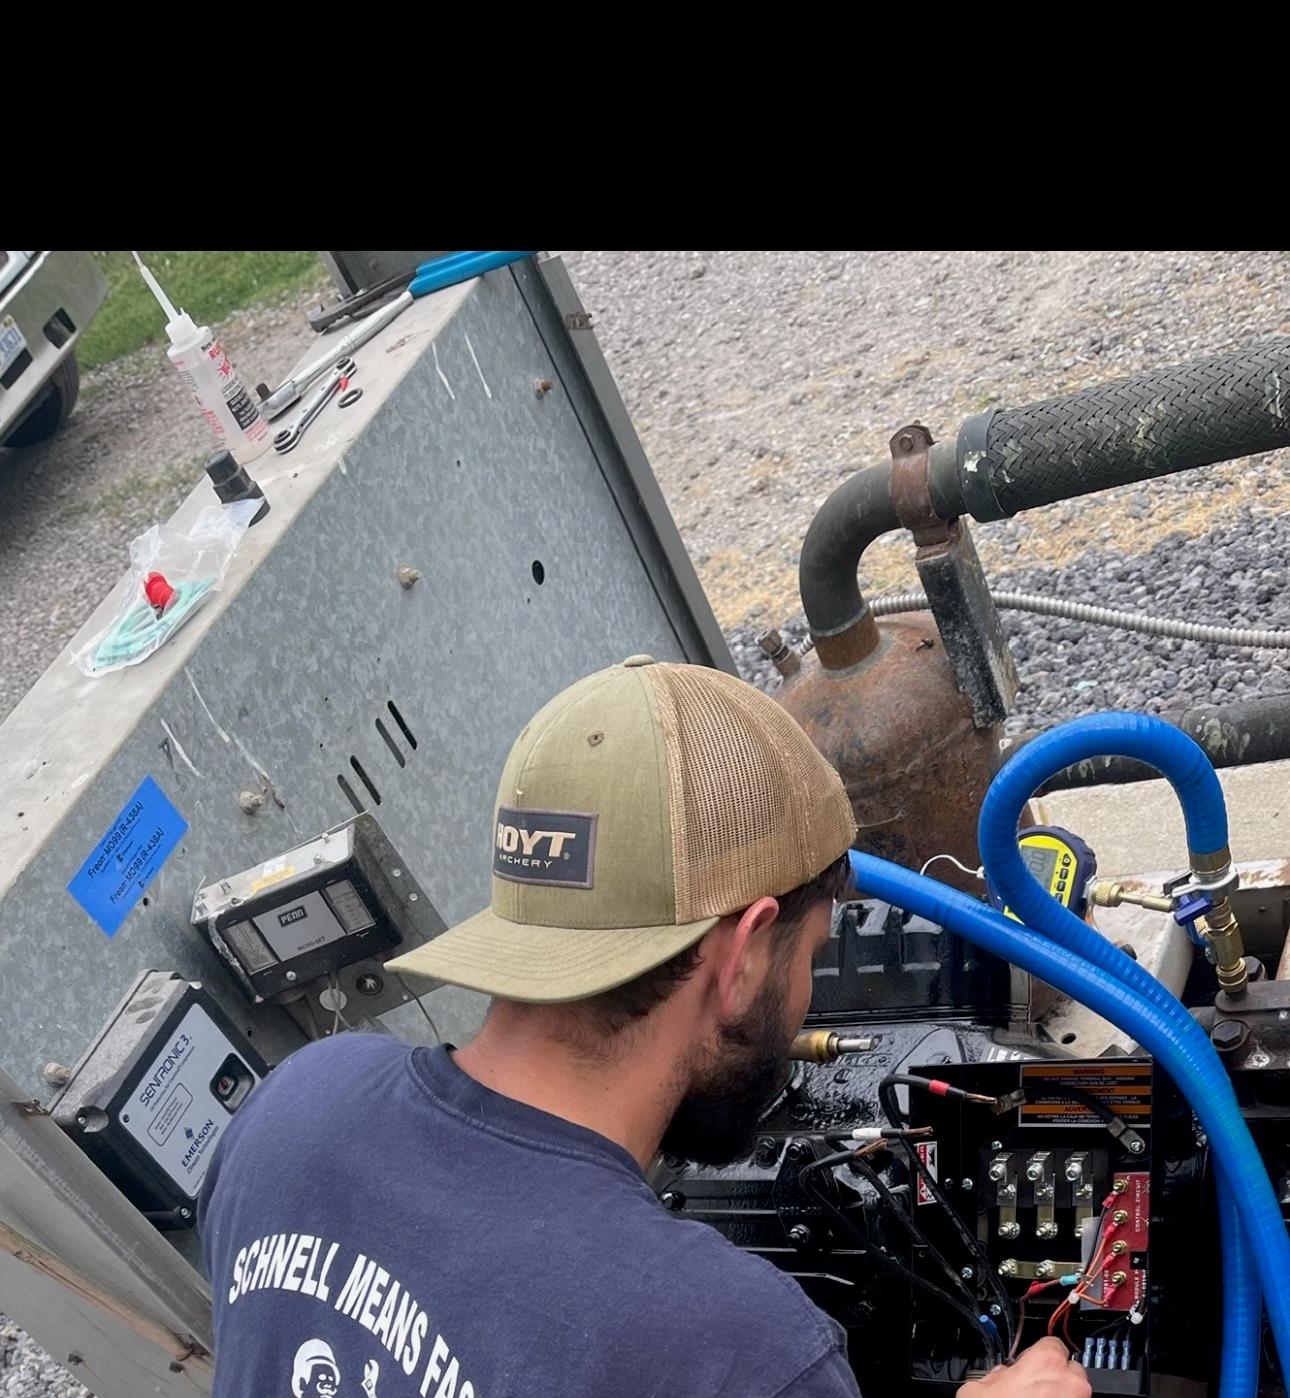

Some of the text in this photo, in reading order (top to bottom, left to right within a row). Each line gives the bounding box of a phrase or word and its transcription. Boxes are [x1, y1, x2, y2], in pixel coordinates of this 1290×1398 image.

[280, 908, 305, 926] PENN
[139, 1041, 186, 1107] SENTRONIC
[181, 1119, 215, 1168] EMERSON
[228, 1233, 340, 1304] SCHNELL
[334, 1253, 428, 1376] MEANS
